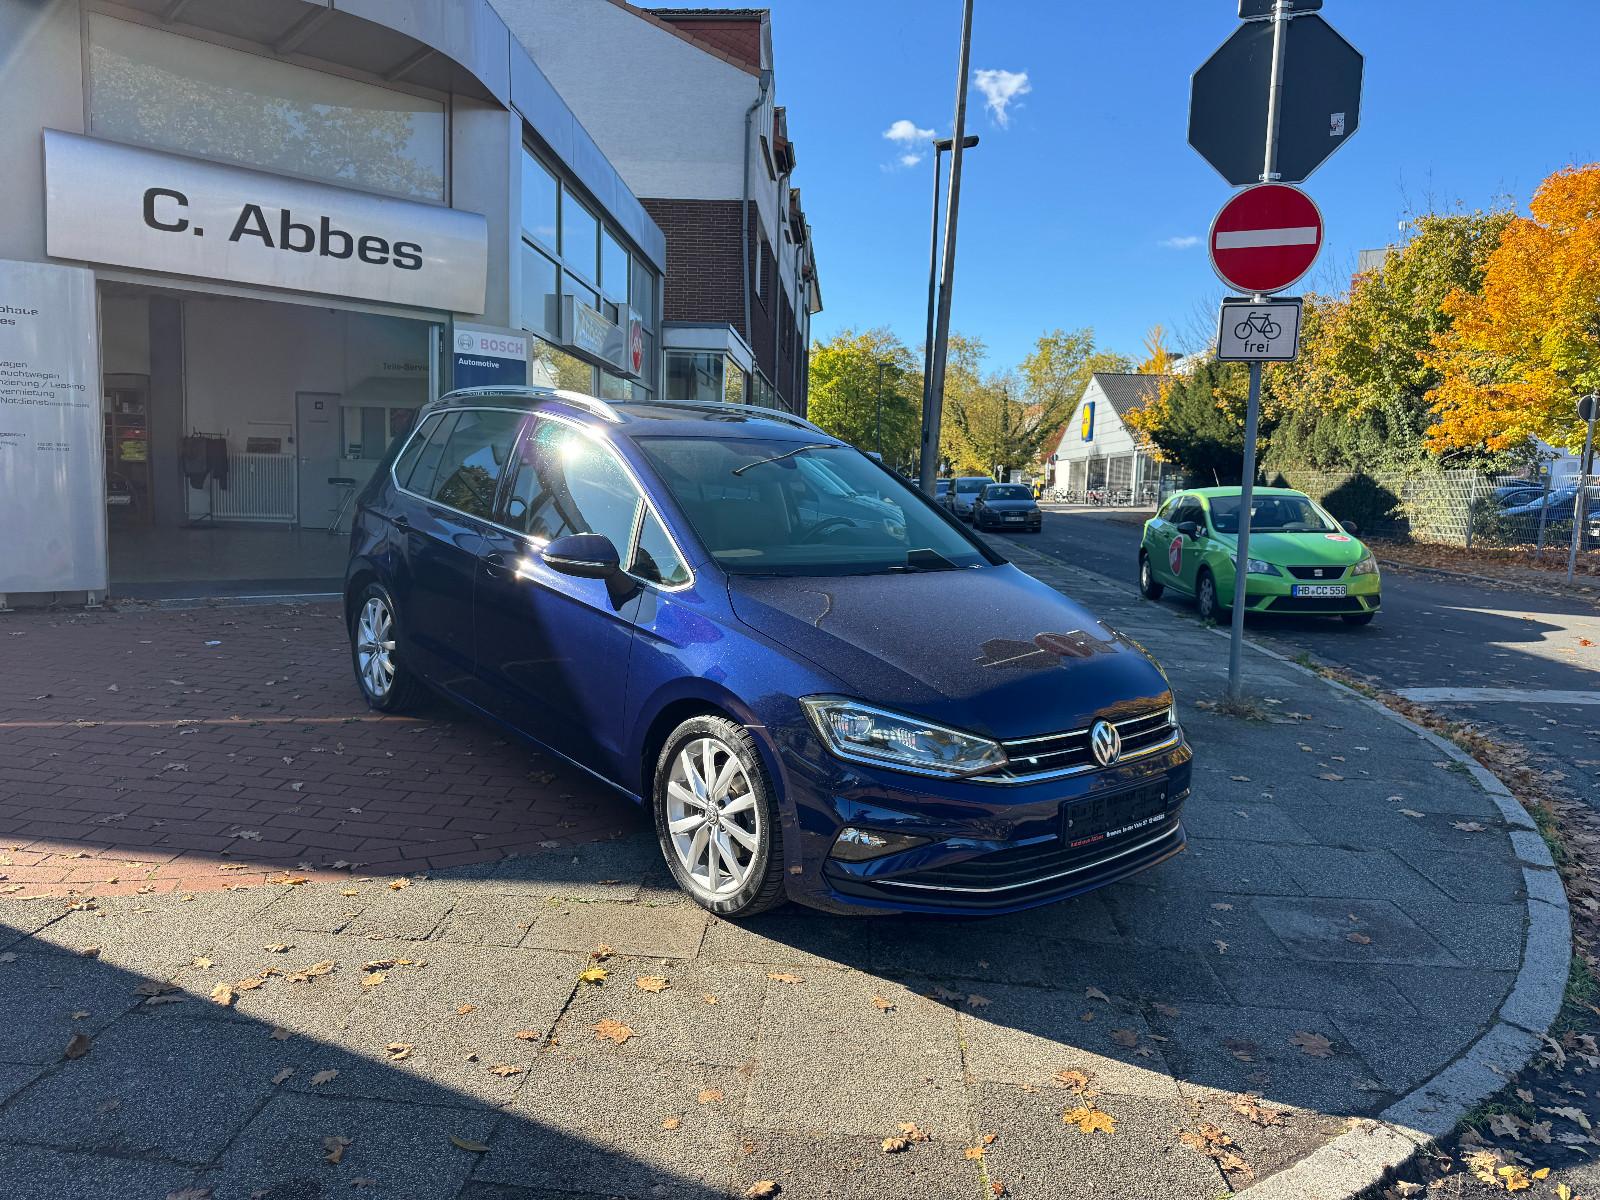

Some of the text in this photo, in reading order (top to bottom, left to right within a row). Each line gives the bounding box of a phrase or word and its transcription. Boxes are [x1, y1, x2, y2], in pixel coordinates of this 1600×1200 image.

[143, 187, 422, 271] C. Abbes
[480, 339, 523, 354] BOSCH
[1244, 340, 1270, 353] frei
[458, 358, 500, 368] Automotive
[50, 382, 86, 392] Leasing
[1297, 586, 1346, 595] HB CC 558
